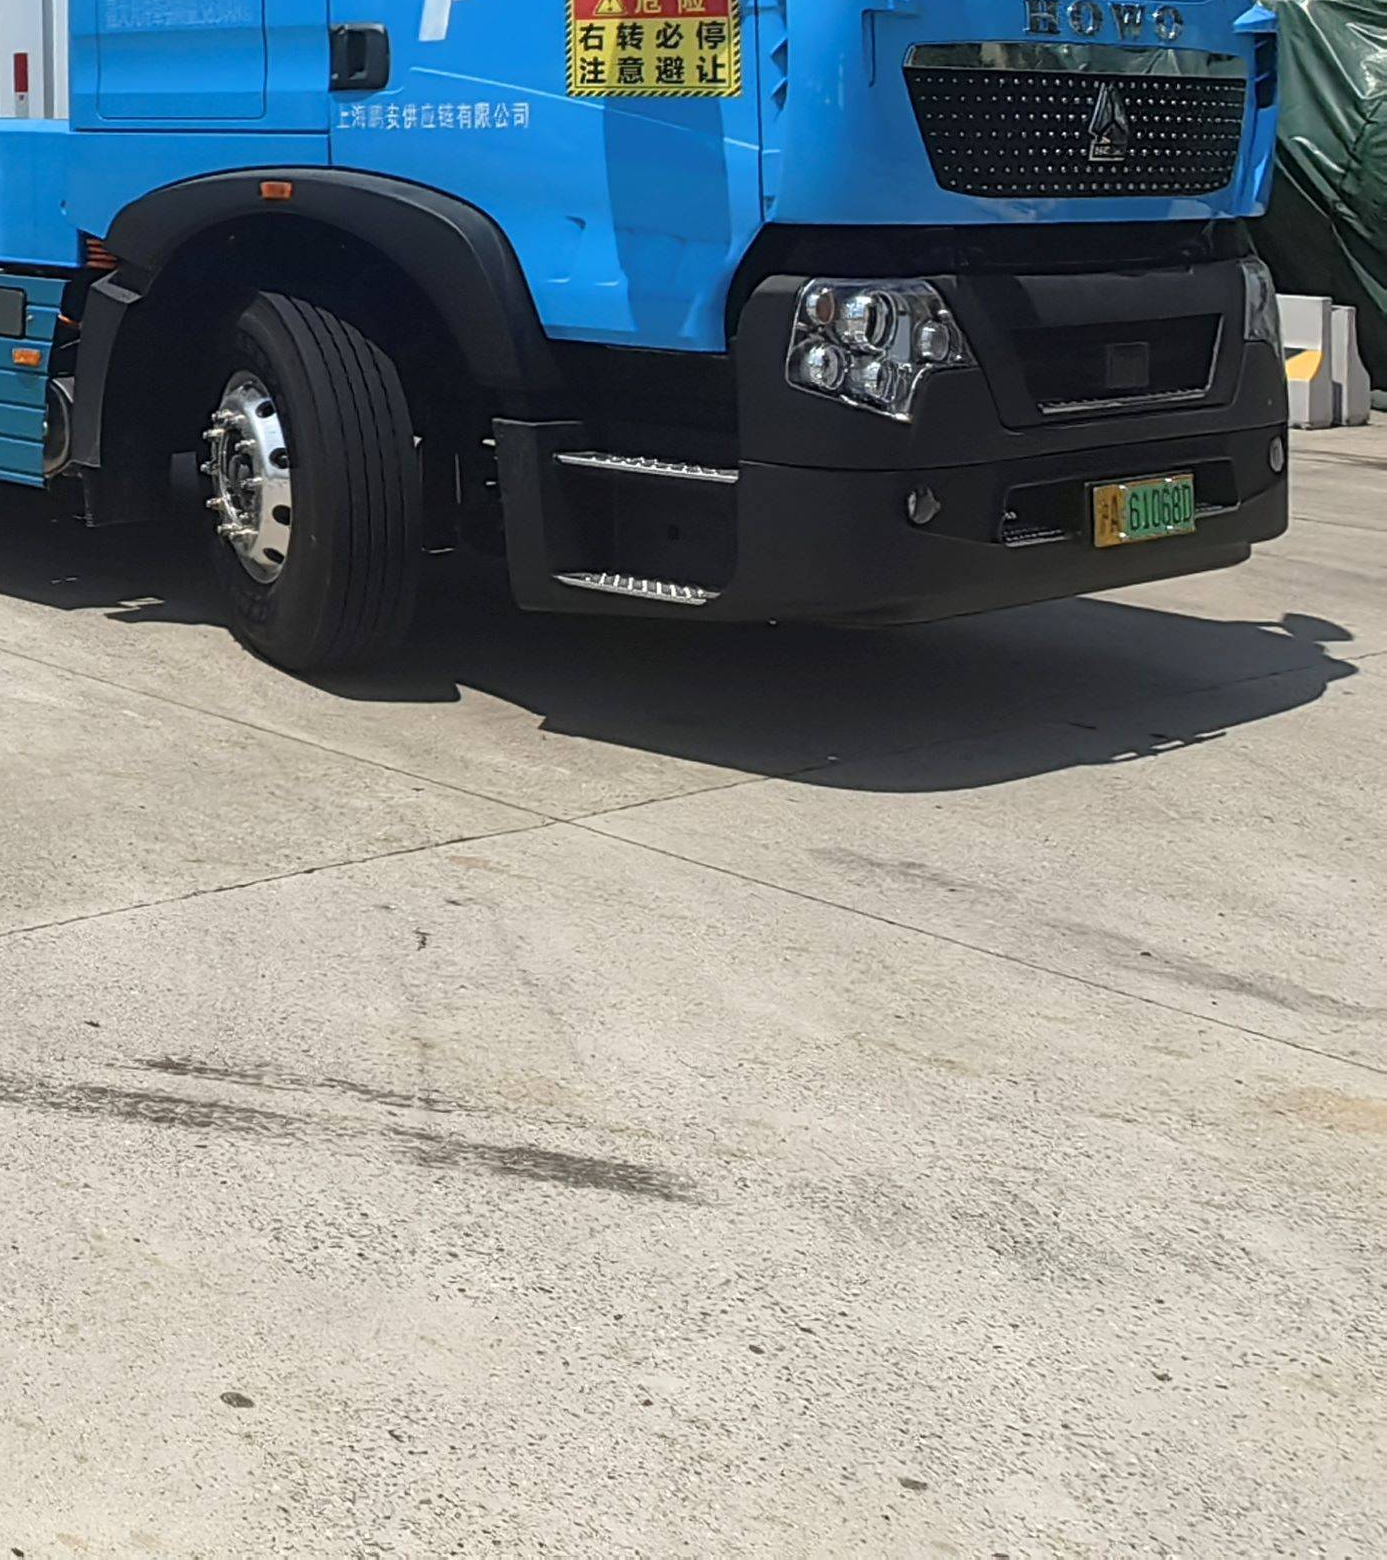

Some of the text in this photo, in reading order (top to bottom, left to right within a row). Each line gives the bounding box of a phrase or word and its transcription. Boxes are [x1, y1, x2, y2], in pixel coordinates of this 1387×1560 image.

[578, 20, 727, 52] 右转必停
[579, 53, 727, 85] 注意避让
